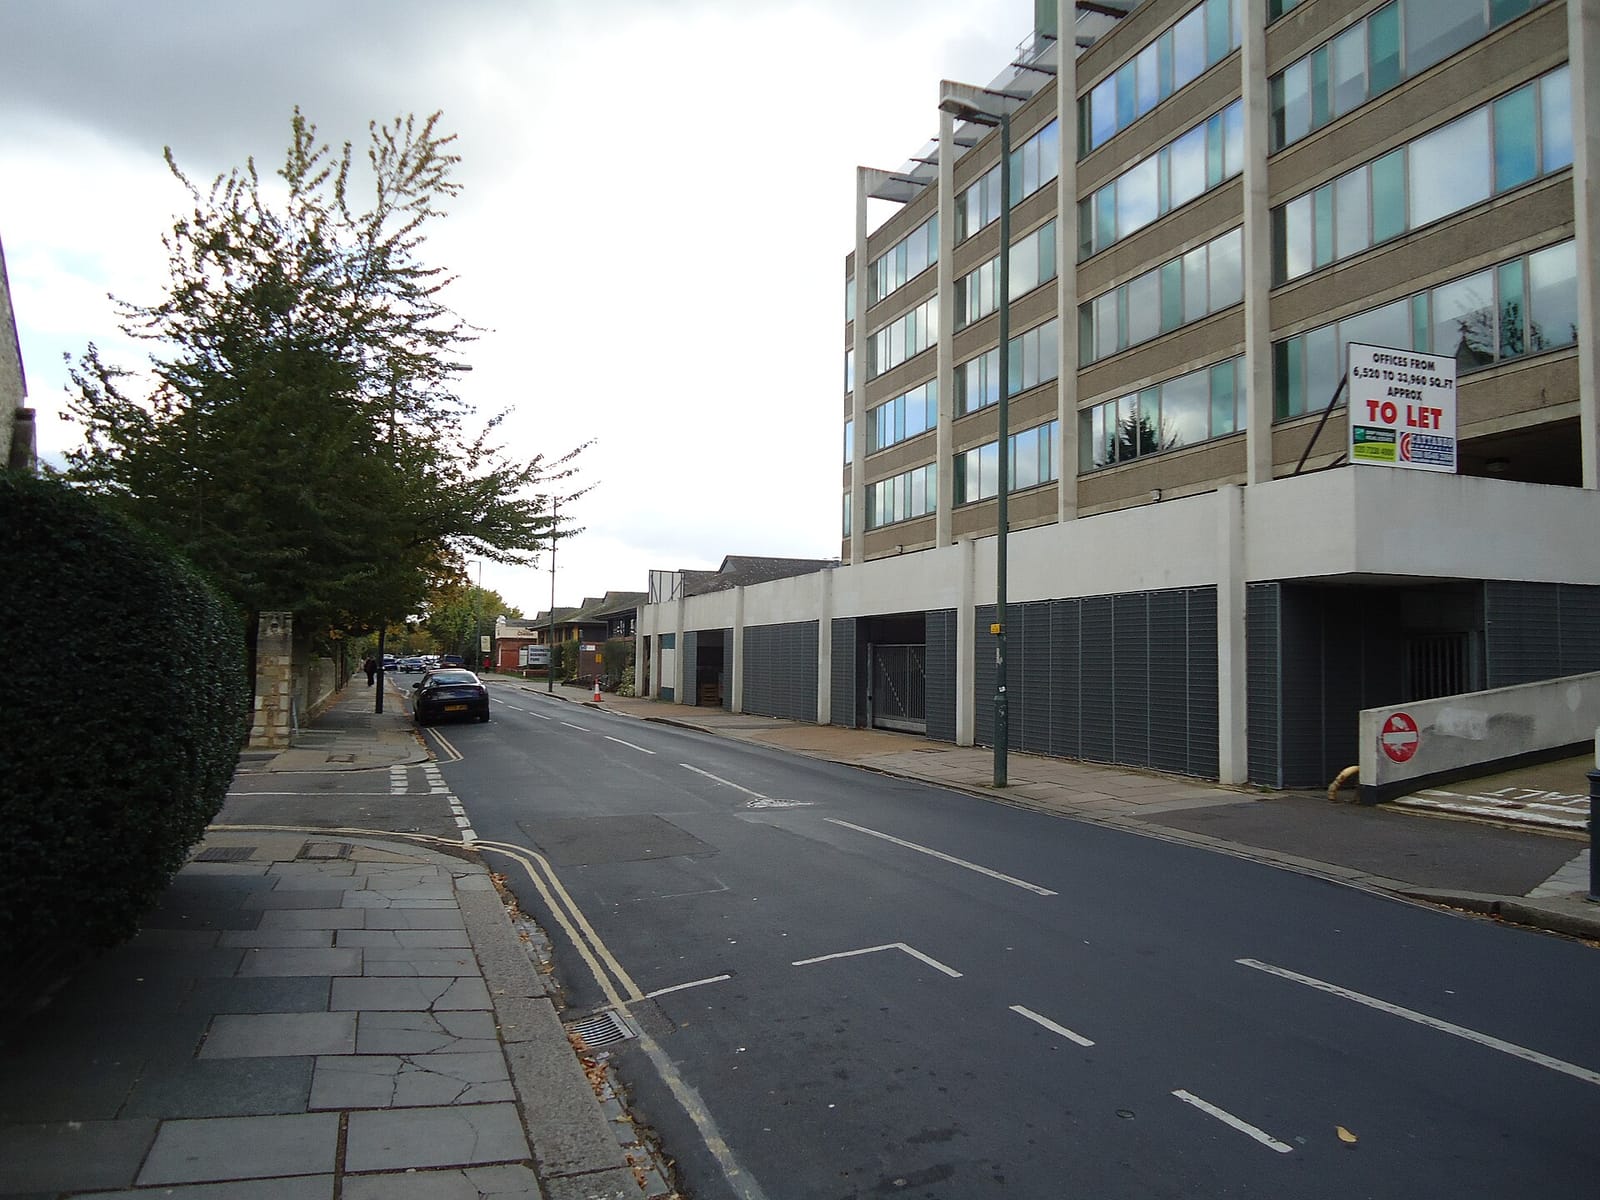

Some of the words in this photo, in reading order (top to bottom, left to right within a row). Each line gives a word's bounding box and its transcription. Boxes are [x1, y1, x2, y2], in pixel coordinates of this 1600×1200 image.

[1373, 353, 1407, 367] OFFICES
[1410, 358, 1435, 371] FROM
[1353, 366, 1380, 379] 6,520
[1383, 370, 1394, 381] TO
[1387, 386, 1422, 401] APPROX
[1366, 400, 1397, 424] TO
[1407, 405, 1442, 429] LET
